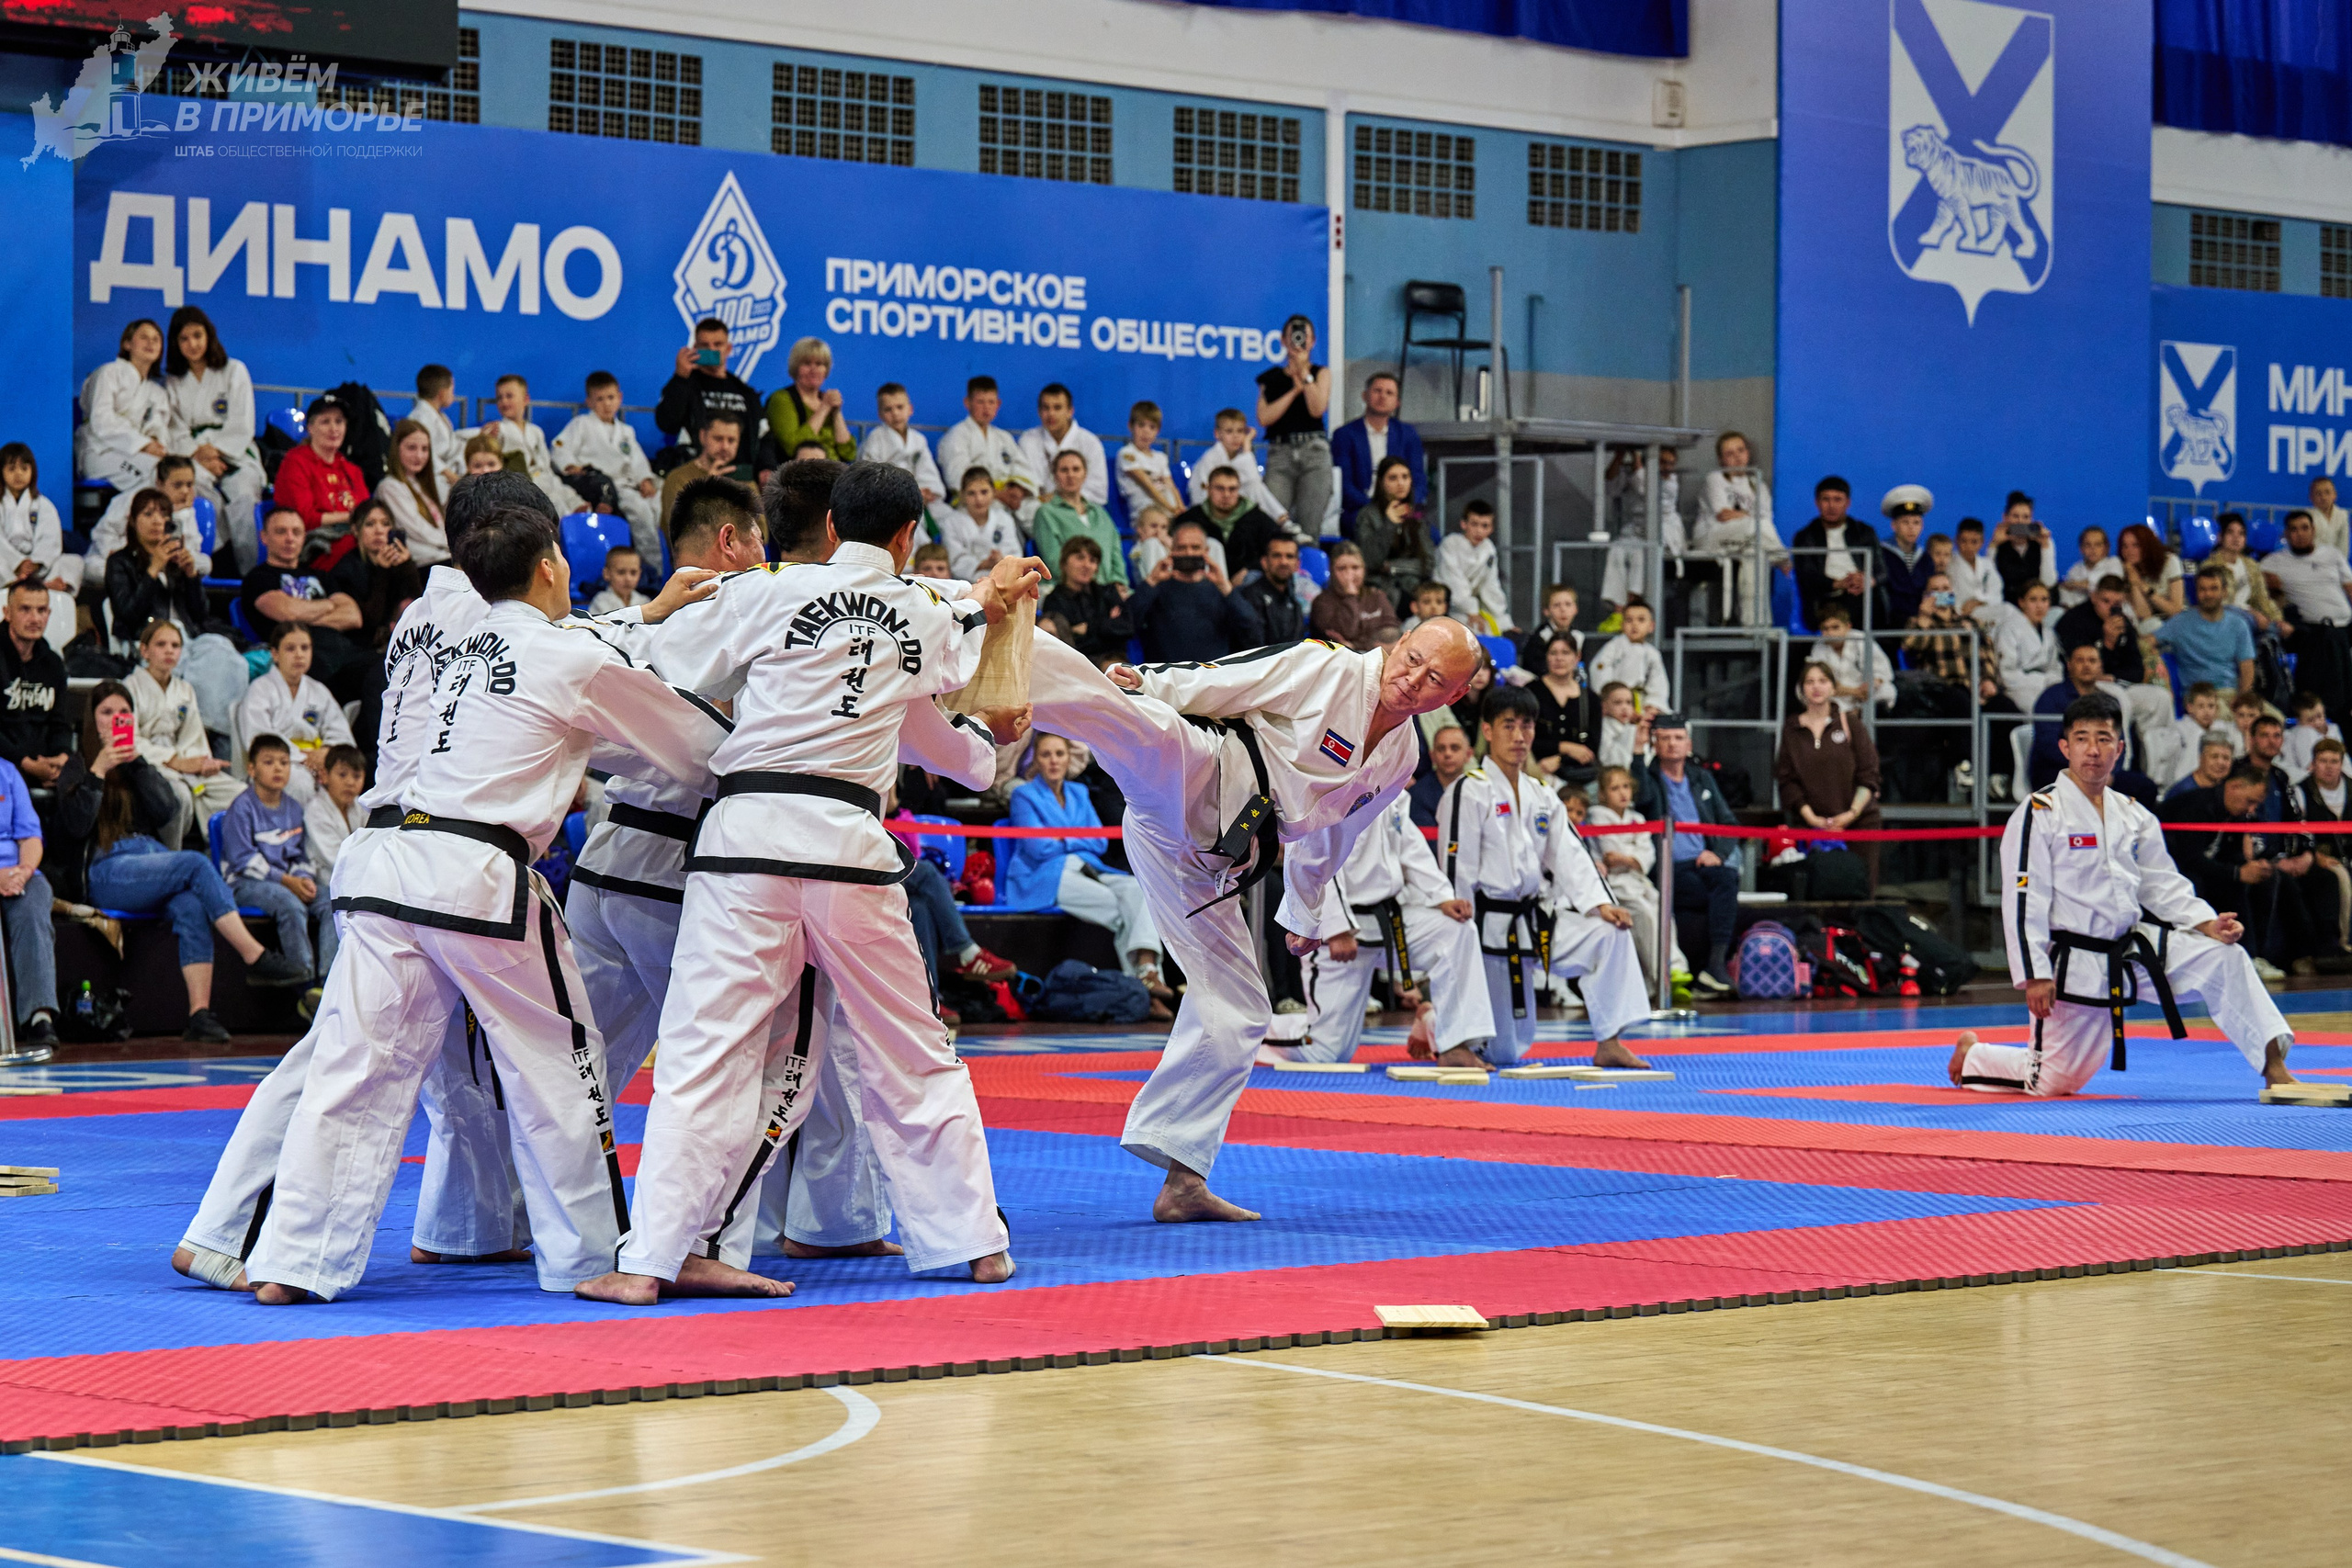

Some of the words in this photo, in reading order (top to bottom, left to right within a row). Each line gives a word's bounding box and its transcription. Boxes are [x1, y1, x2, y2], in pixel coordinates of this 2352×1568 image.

[90, 190, 623, 321] ДИНАМО
[826, 257, 1087, 310] ПРИМОРСКОЕ
[826, 298, 1081, 349] СПОРТИВНОЕ
[1091, 316, 1288, 364] ОБЩЕСТВО
[2268, 423, 2352, 478] ПРИ
[785, 592, 922, 675] TAEKWON-DO
[850, 624, 876, 636] ITF
[458, 660, 477, 671] ITF
[571, 1048, 589, 1064] ITF
[785, 1055, 806, 1069] ITF
